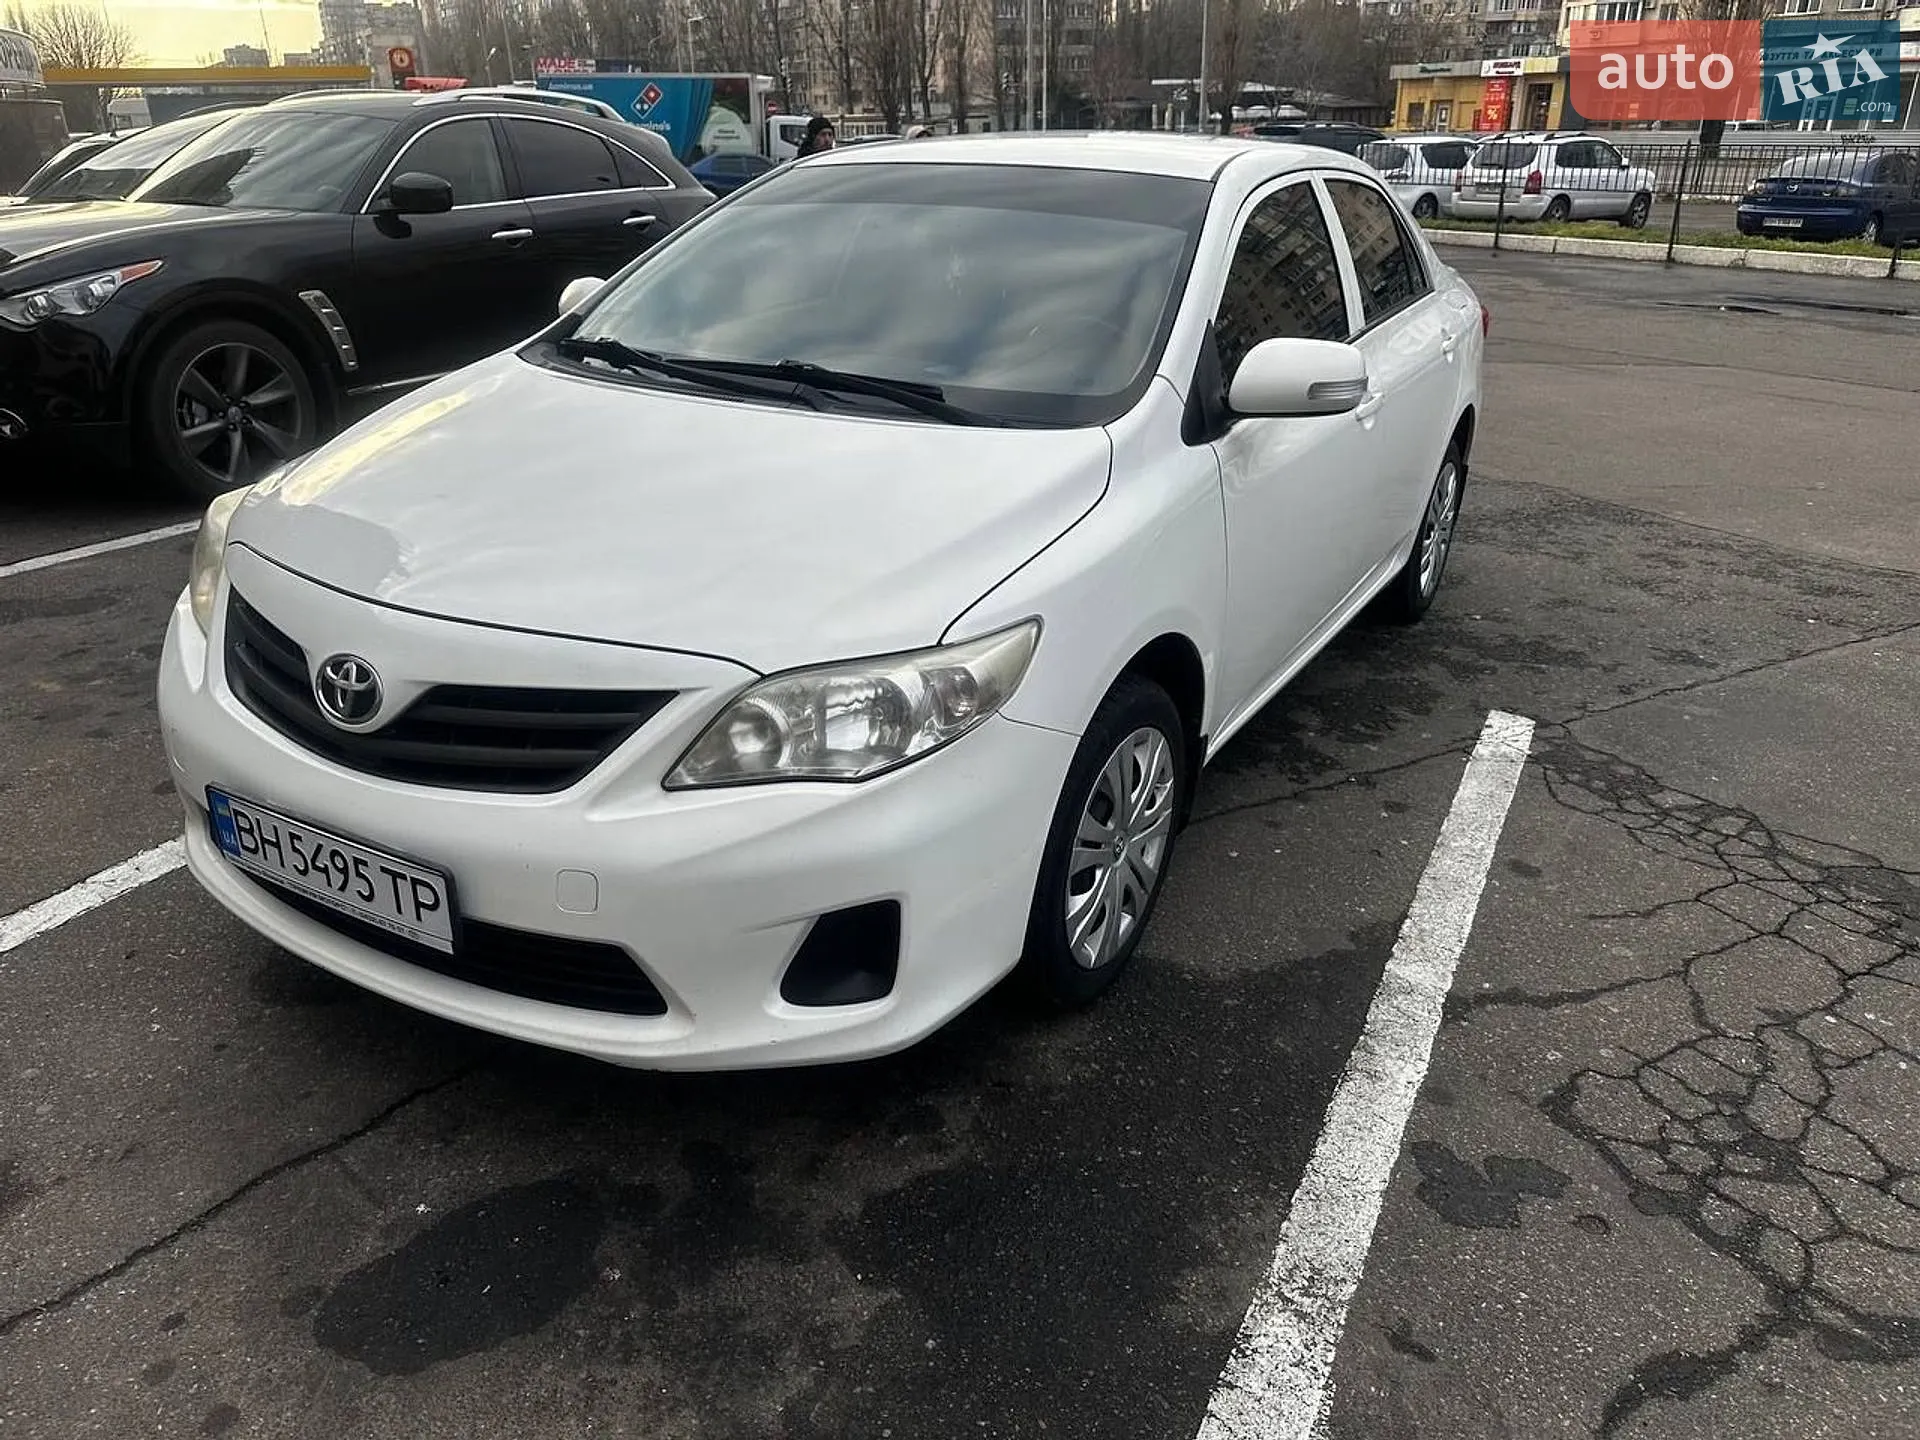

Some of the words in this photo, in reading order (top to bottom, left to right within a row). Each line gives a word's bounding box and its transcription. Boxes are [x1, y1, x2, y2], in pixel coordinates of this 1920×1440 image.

[1820, 47, 1884, 60] АКСЕСУРИ
[535, 56, 576, 69] MADE
[233, 807, 285, 868] BH
[289, 831, 375, 903] 5495
[380, 865, 440, 922] TP
